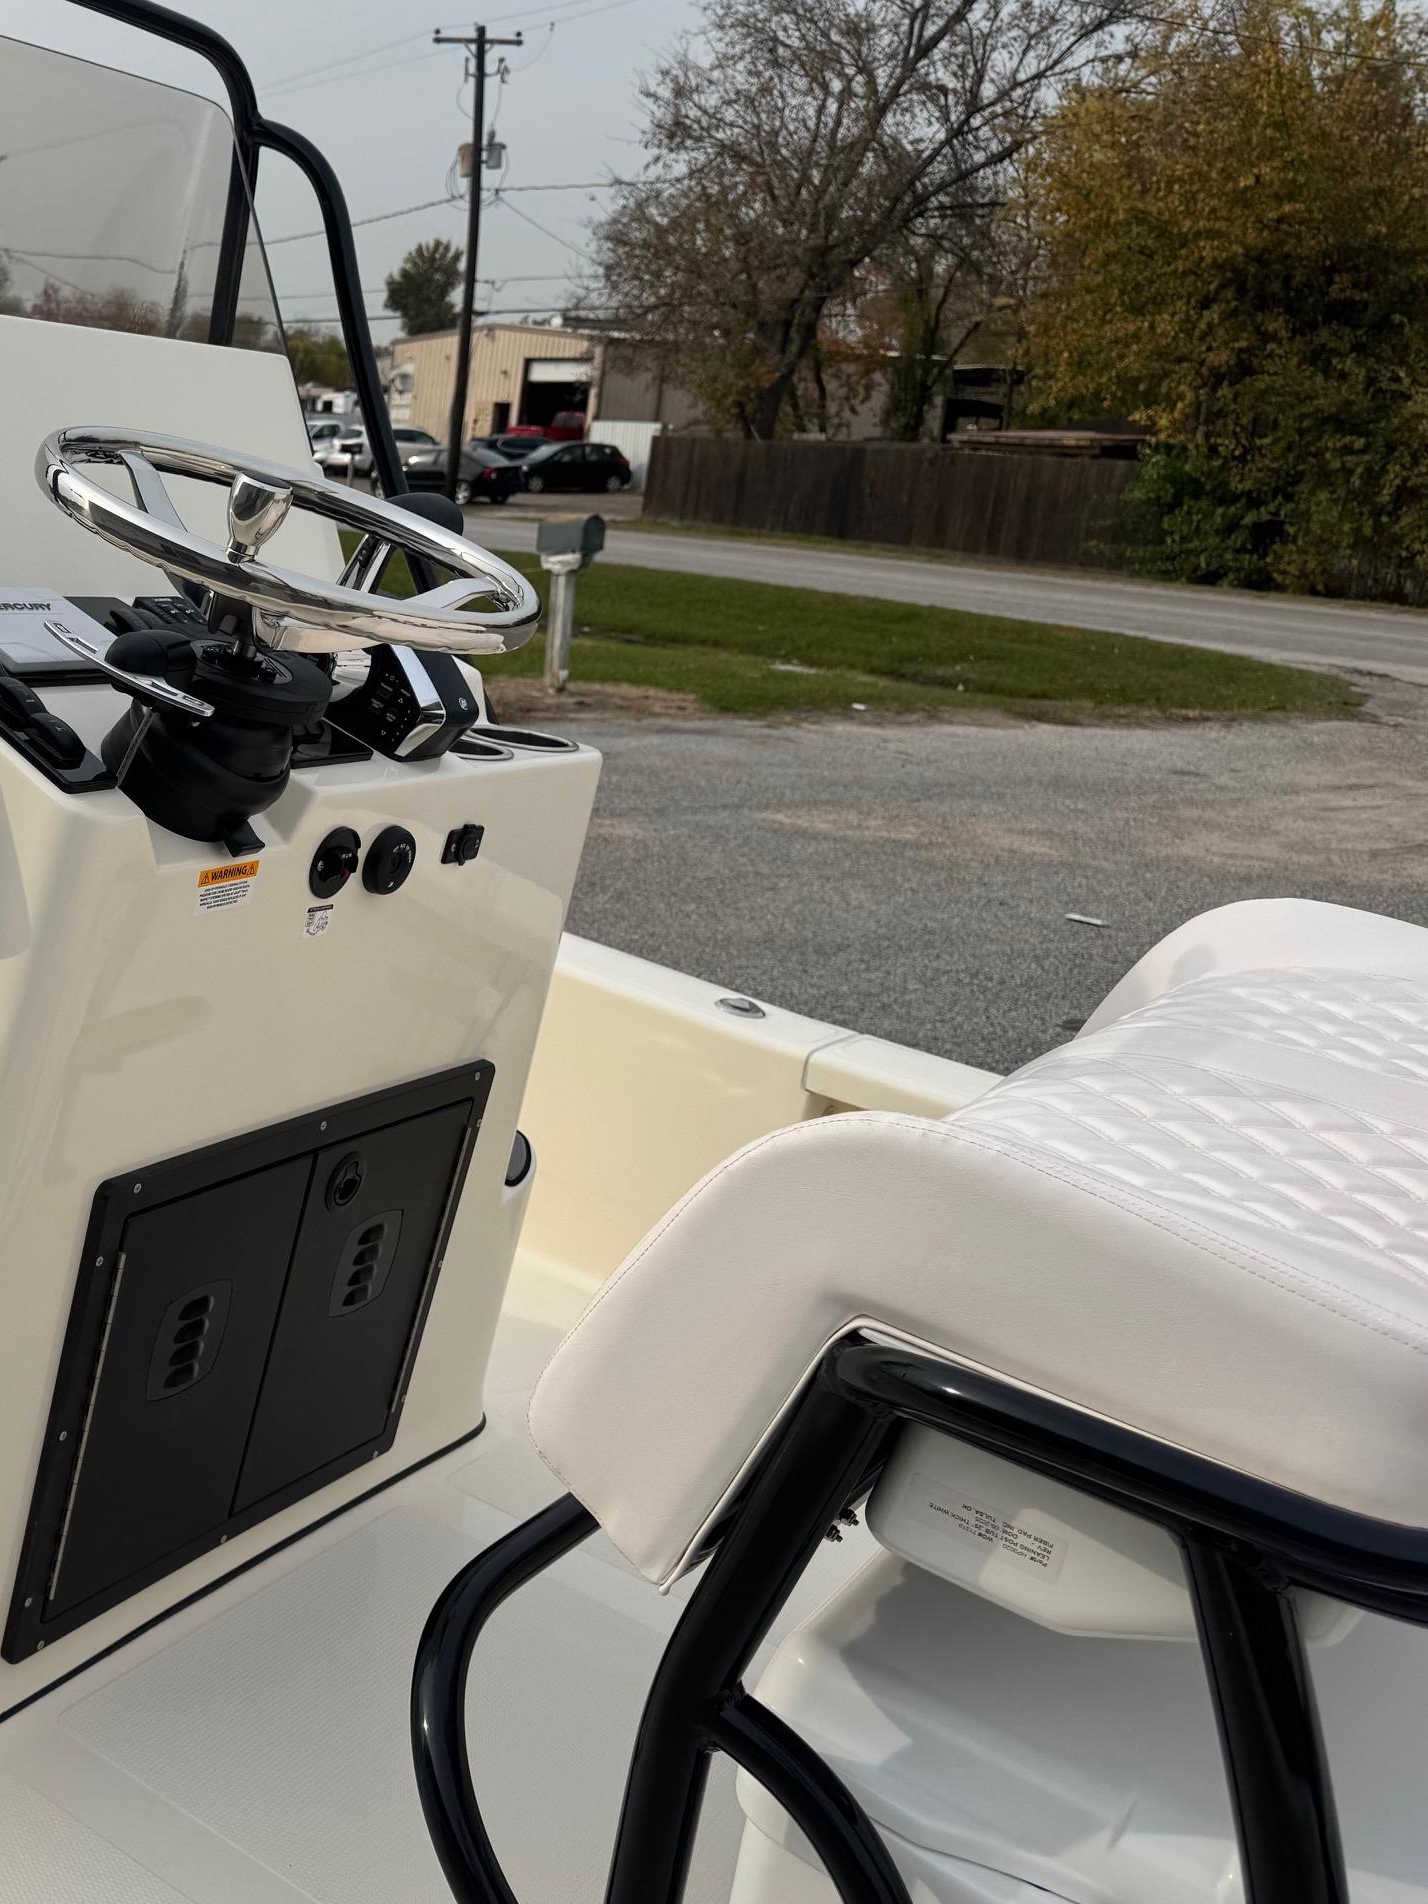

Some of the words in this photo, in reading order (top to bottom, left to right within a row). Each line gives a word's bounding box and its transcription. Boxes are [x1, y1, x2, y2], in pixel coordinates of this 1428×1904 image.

[211, 865, 248, 882] WARNING
[928, 1502, 950, 1515] WHITE
[949, 1512, 970, 1525] THICK
[984, 1528, 999, 1538] TUB
[1000, 1535, 1018, 1547] POST
[1033, 1536, 1054, 1549] FIBER
[1019, 1544, 1050, 1561] LEANING
